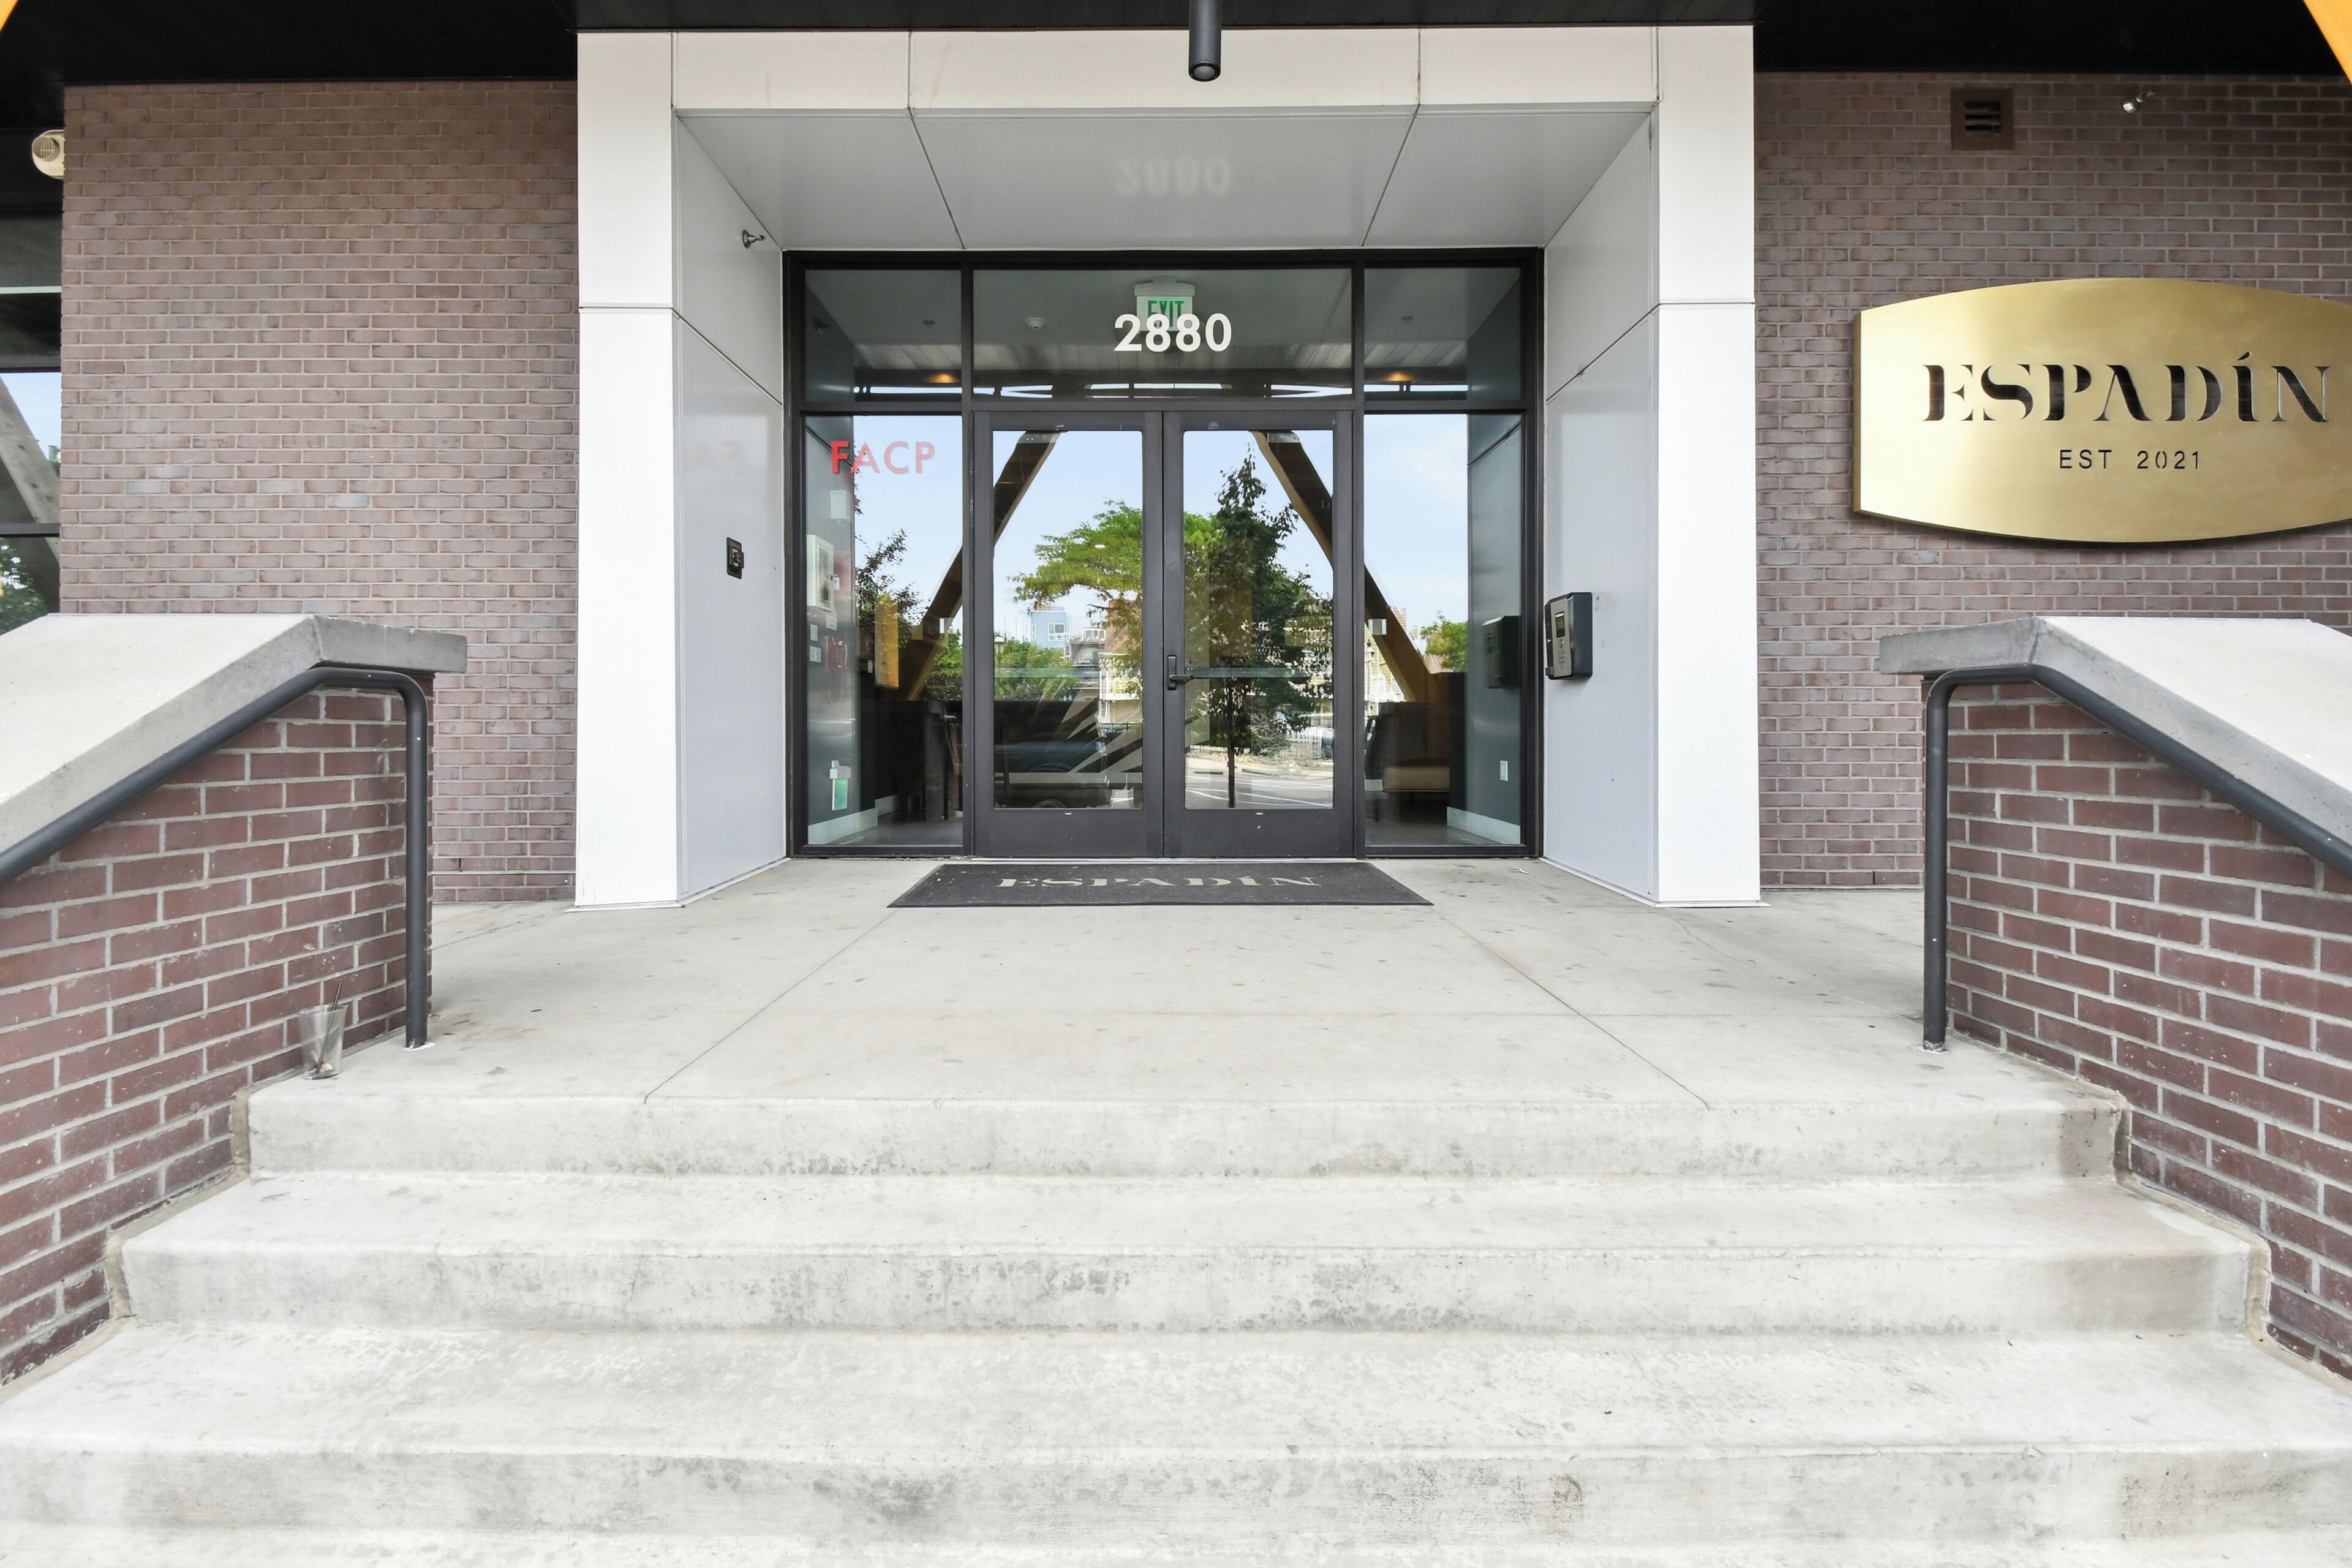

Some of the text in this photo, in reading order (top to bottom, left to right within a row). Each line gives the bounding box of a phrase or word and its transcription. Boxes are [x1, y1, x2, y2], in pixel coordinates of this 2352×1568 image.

[1114, 312, 1232, 352] 2880
[1921, 351, 2330, 423] ESPADÍN
[831, 440, 935, 474] FACP
[2059, 449, 2199, 470] EST 2021
